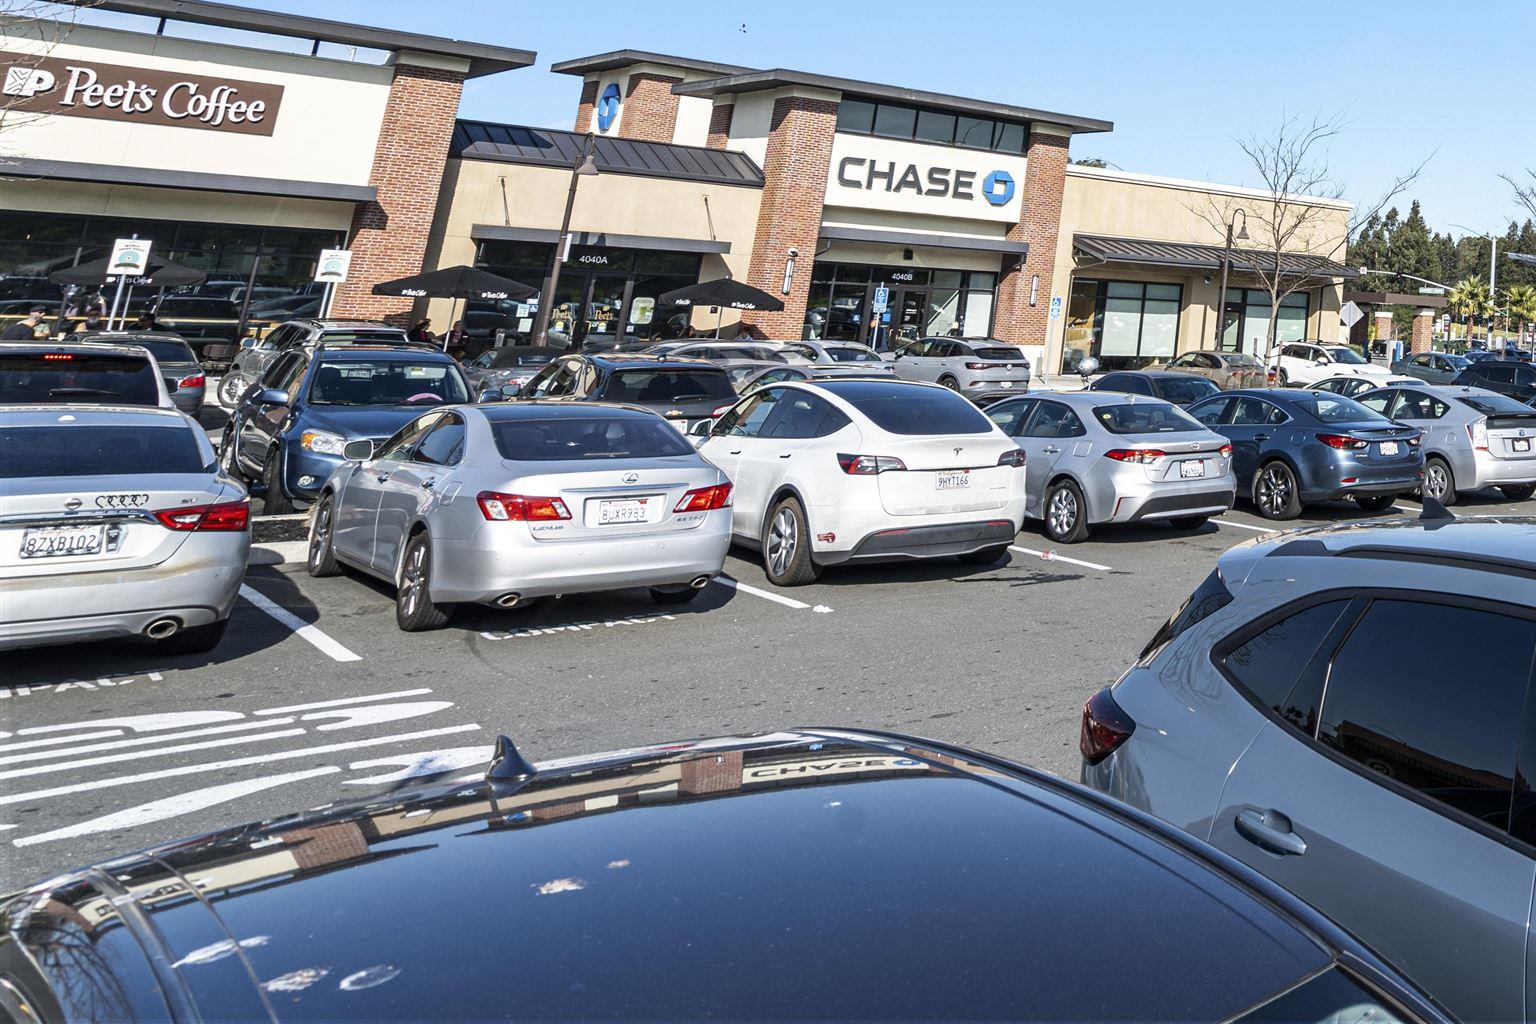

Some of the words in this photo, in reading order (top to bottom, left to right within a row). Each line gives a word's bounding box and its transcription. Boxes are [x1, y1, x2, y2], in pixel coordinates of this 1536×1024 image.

[59, 66, 156, 113] Peet's
[162, 81, 266, 126] Coffee
[837, 156, 977, 201] CHASE
[579, 255, 608, 265] 4040A
[891, 273, 913, 281] 4040B
[938, 475, 969, 488] 9HYT166
[26, 535, 96, 553] 8ZXB102
